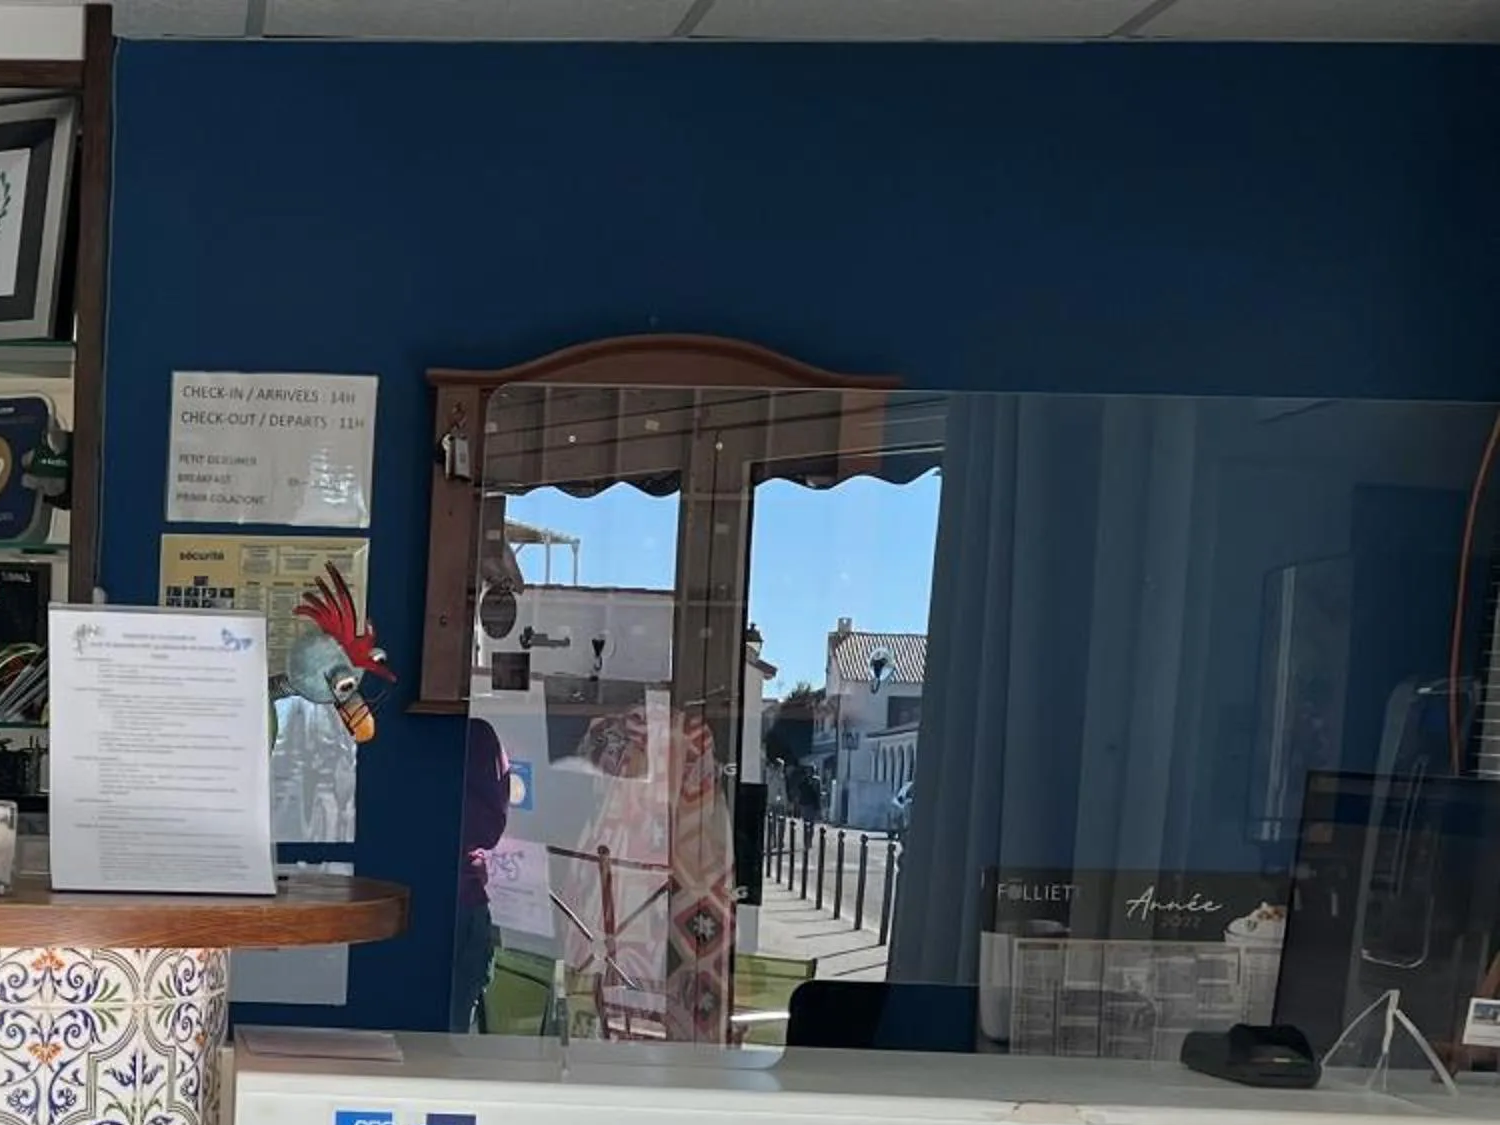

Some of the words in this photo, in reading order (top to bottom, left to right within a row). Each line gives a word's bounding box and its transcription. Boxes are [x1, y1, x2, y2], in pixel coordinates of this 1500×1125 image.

[182, 385, 243, 400] CHECK-IN
[181, 411, 256, 426] CHECK-OUT
[1125, 886, 1223, 921] Année
